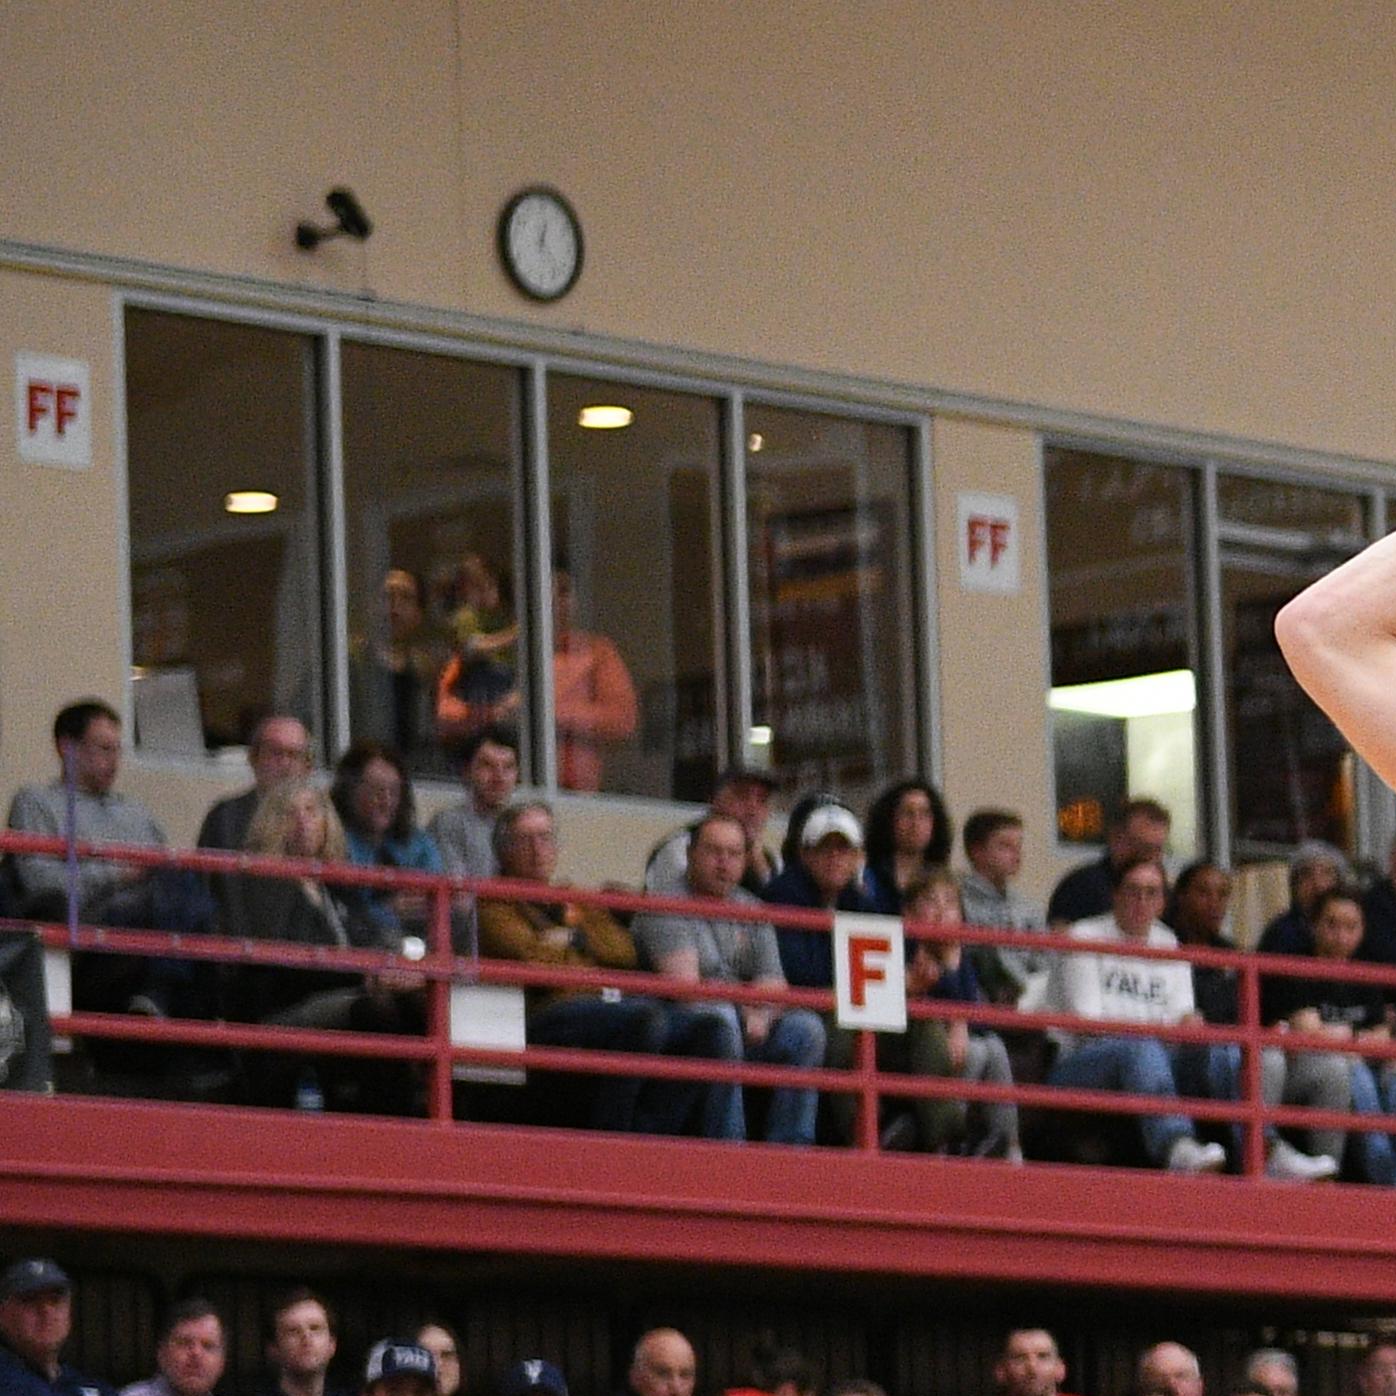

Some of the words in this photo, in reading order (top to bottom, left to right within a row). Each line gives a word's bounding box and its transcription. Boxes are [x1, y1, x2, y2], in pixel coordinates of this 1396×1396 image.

[27, 381, 81, 436] FF
[967, 514, 1010, 568] FF
[848, 935, 892, 1007] F
